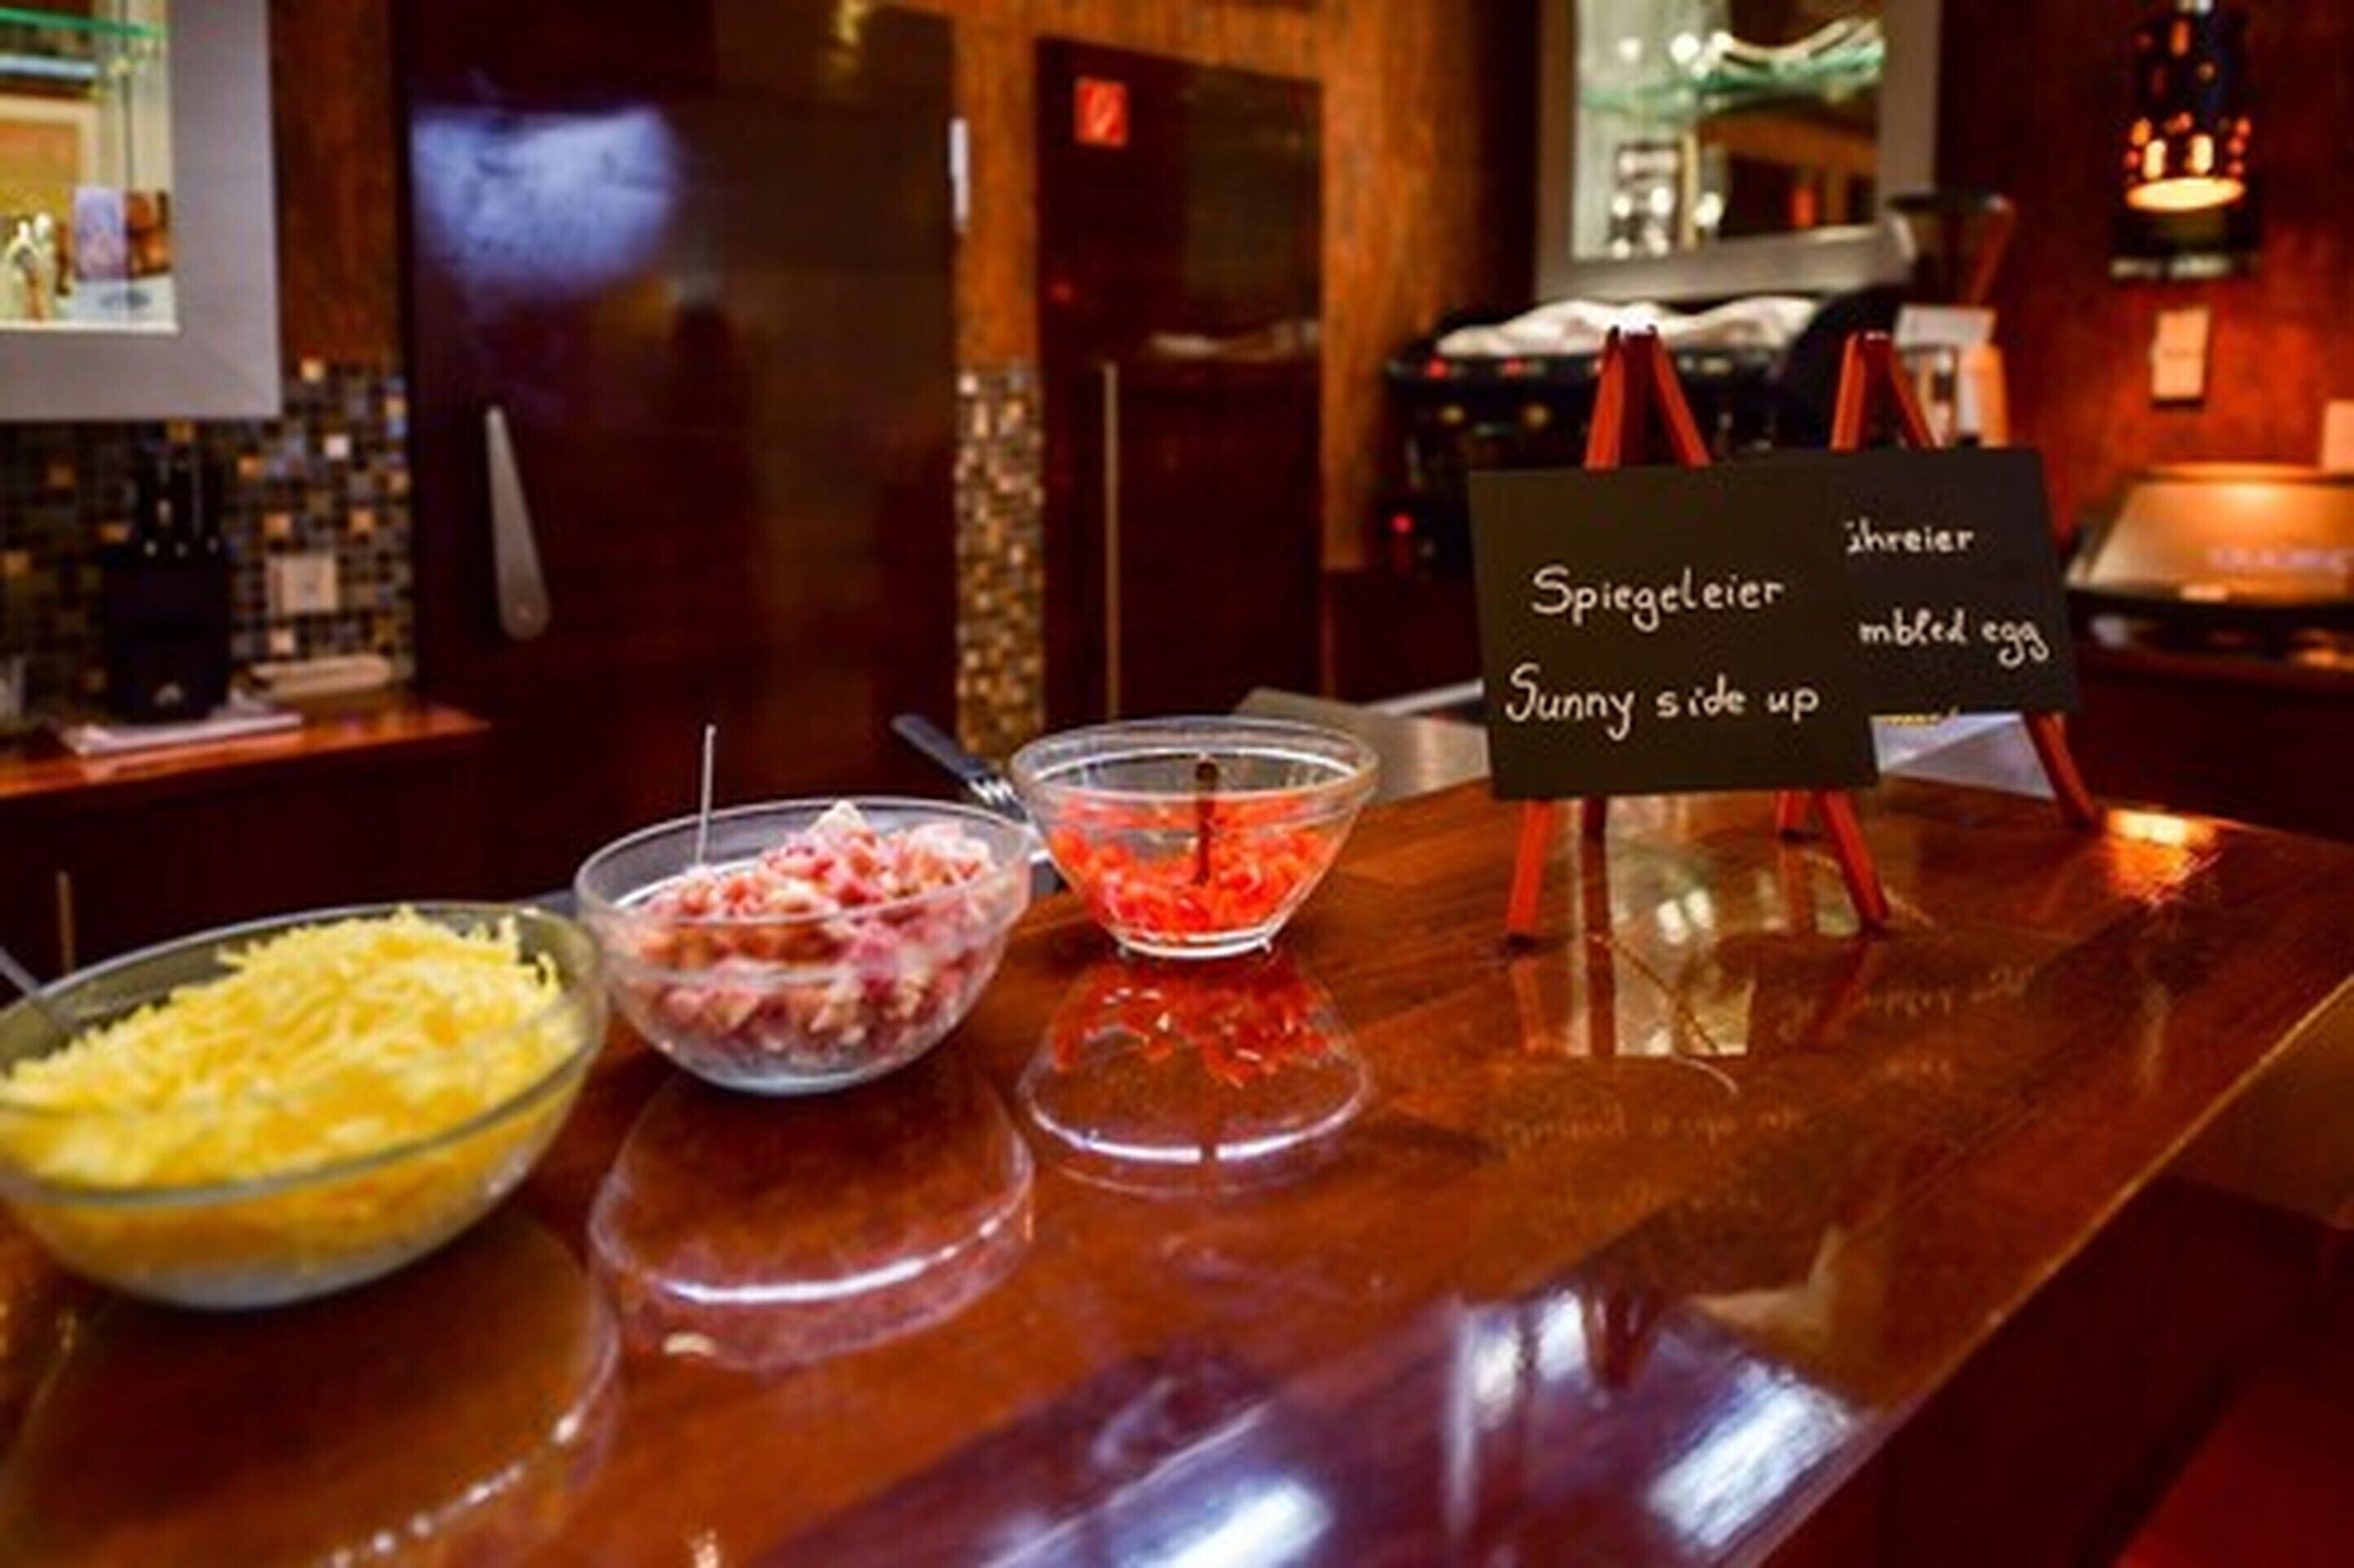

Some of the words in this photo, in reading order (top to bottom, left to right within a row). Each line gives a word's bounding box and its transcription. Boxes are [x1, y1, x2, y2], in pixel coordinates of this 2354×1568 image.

[1531, 564, 1785, 633] Spiegeleier
[1981, 621, 2050, 668] egg
[1504, 661, 1636, 741] Sunny
[1655, 673, 1747, 718] side
[1767, 687, 1820, 723] up
